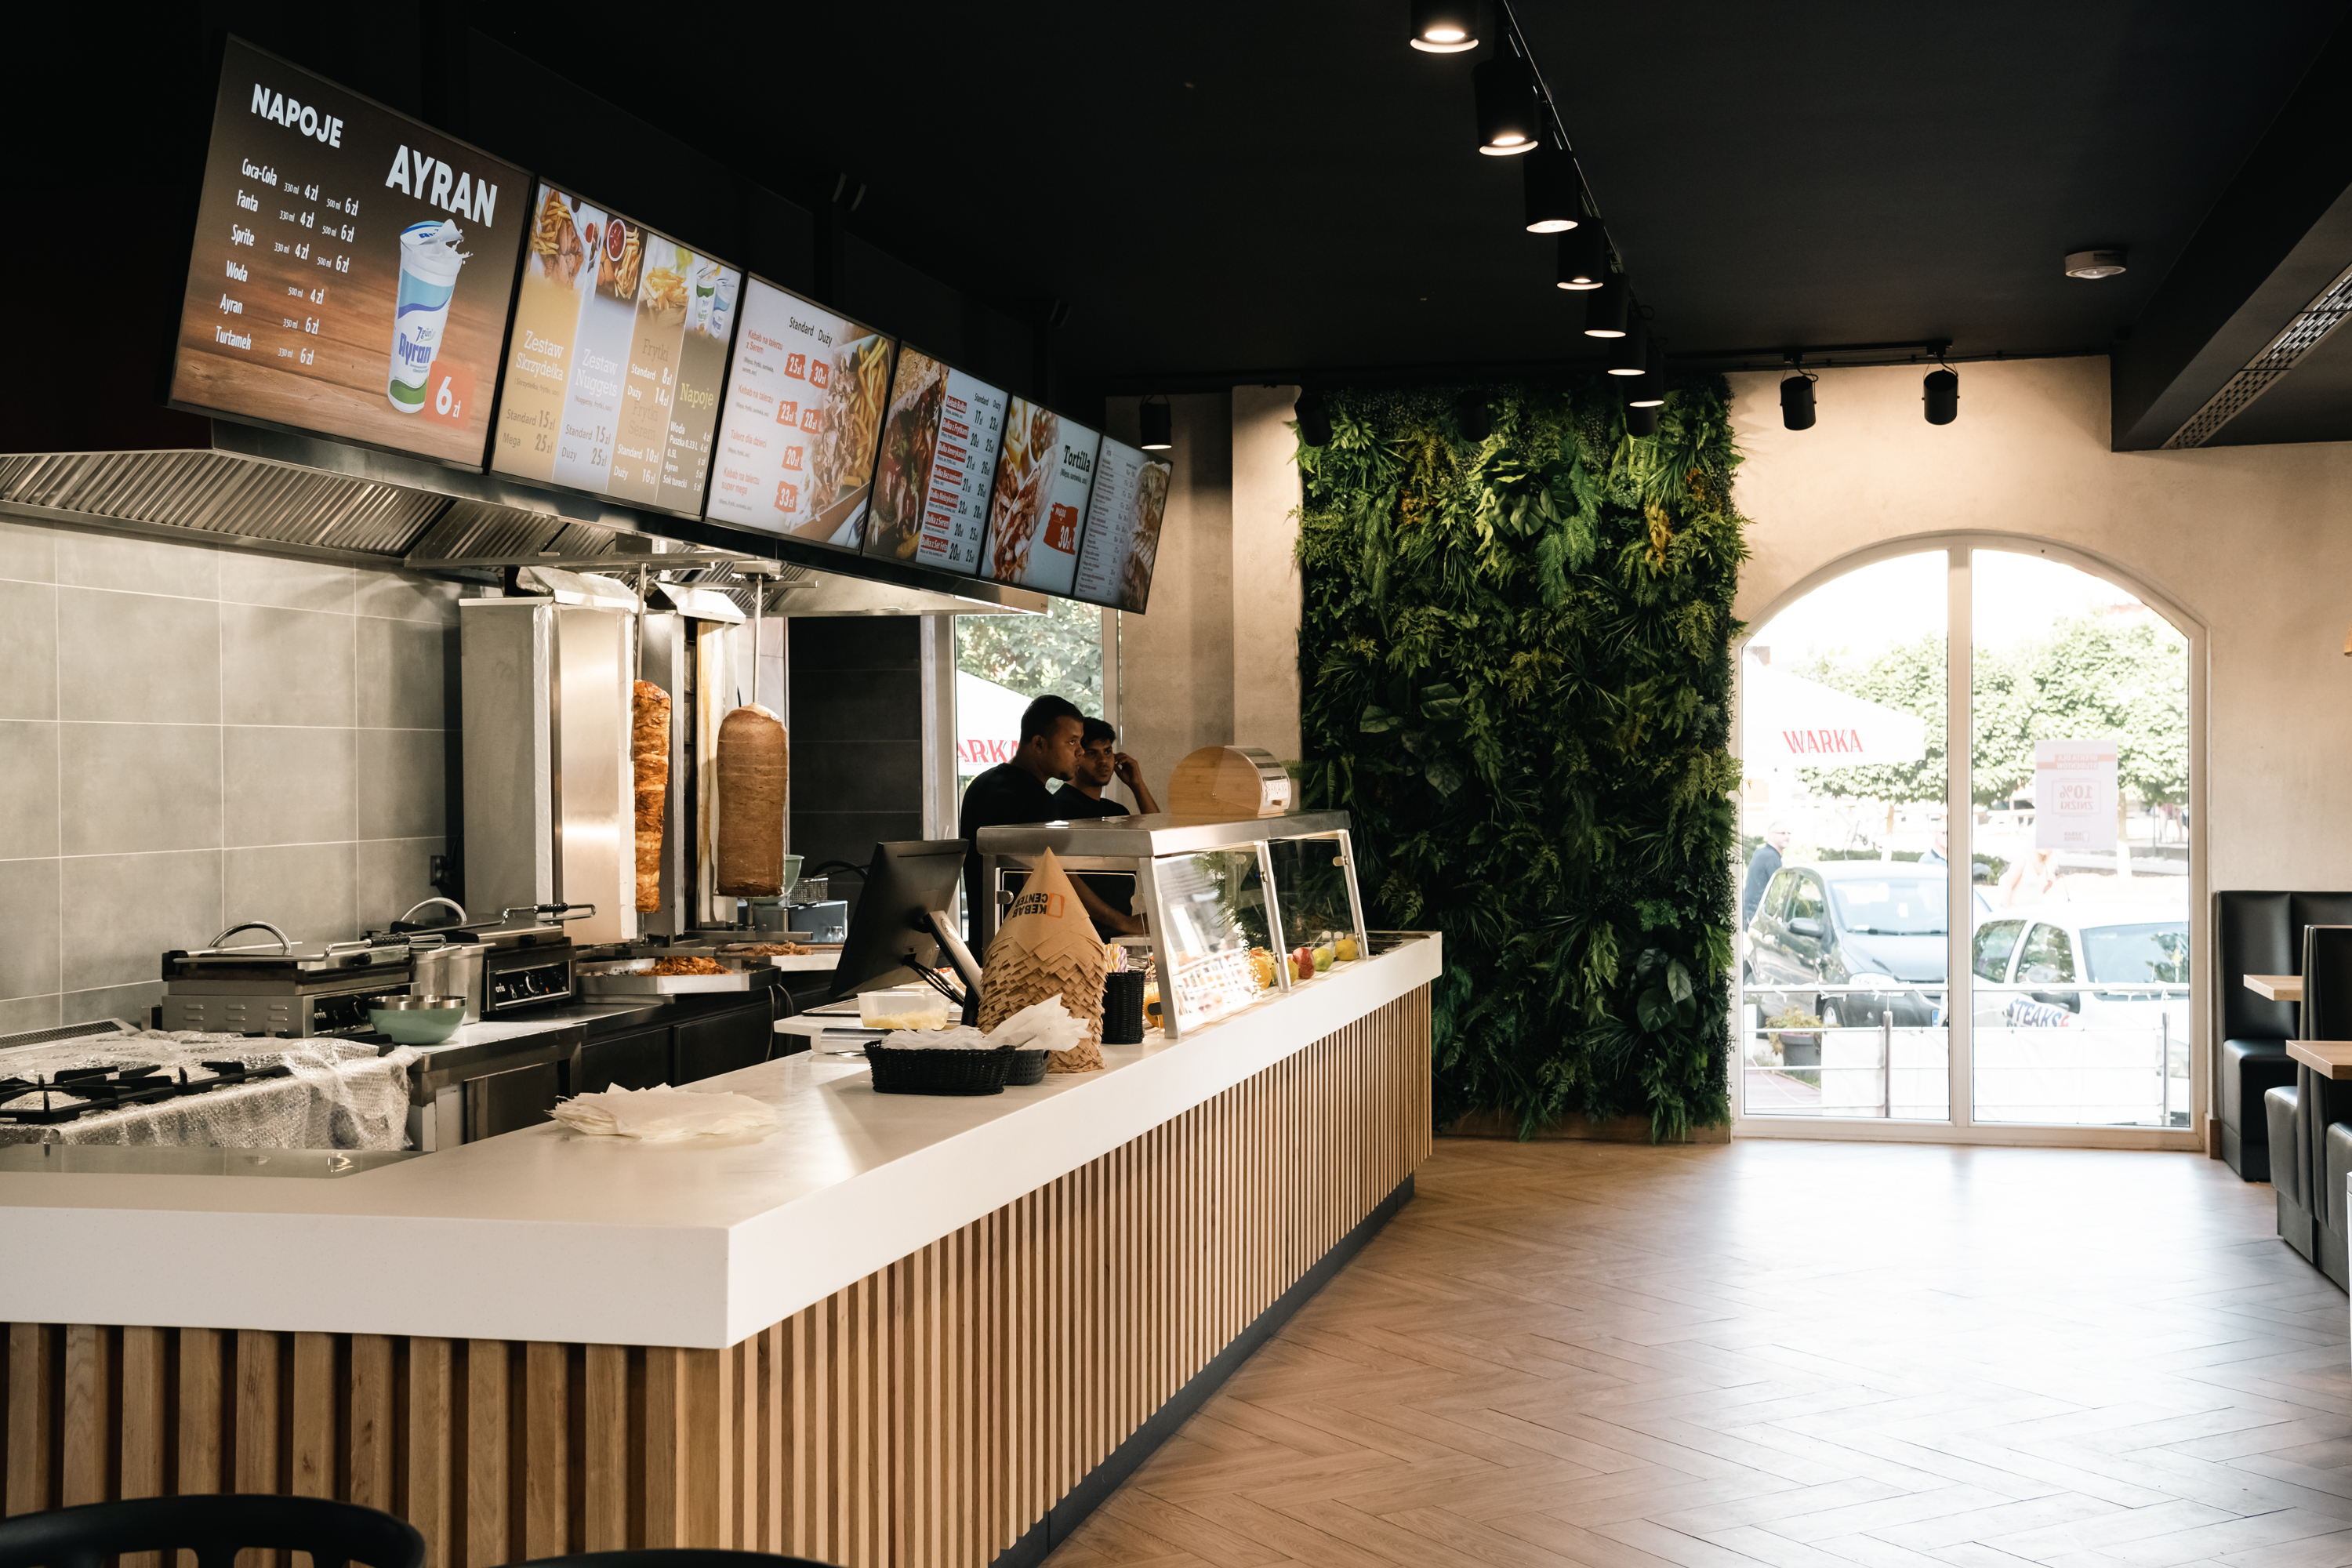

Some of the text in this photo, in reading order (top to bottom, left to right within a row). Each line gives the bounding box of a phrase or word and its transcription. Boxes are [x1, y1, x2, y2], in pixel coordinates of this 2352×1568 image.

[251, 83, 343, 149] NAPOJE
[241, 158, 278, 187] Coca-Cola
[284, 182, 293, 193] 330
[304, 184, 310, 198] 4
[326, 198, 336, 209] 500
[345, 198, 351, 213] 6
[386, 144, 498, 227] AYRAN
[237, 189, 259, 212] Fanta
[279, 210, 289, 220] 330
[299, 212, 306, 226] 4
[321, 226, 331, 235] 500
[340, 224, 347, 240] 6
[231, 223, 255, 246] Sprite
[274, 242, 284, 252] 330
[295, 243, 301, 258] 4
[317, 256, 326, 267] 500
[336, 255, 343, 271] 6
[226, 260, 249, 282] Woda
[288, 287, 298, 296] 500
[310, 289, 316, 303] 4
[220, 293, 243, 314] Ayran
[283, 318, 292, 328] 350
[305, 317, 312, 333] 6
[524, 329, 564, 359] Zestaw
[748, 329, 783, 350] Kebab na talerzu
[789, 316, 833, 348] Standard Duży
[216, 325, 252, 350] Turtamek
[278, 347, 287, 358] 330
[299, 347, 307, 364] 6
[398, 332, 432, 365] Ayran
[641, 338, 669, 362] Frytki
[750, 342, 764, 354] Serem
[516, 352, 564, 381] Skrzydełka
[582, 348, 619, 376] Zestaw
[630, 363, 656, 381] Standard
[575, 368, 618, 397] Nuggets
[627, 385, 642, 401] Duży
[738, 384, 753, 397] Kebab
[759, 392, 775, 404] talerzu
[436, 376, 461, 418] 6 zł
[679, 383, 714, 410] Napoje
[506, 408, 536, 426] Standard
[632, 400, 659, 423] Frytki
[564, 423, 593, 441] Standard
[670, 420, 685, 435] Woda
[731, 429, 745, 442] Talerz
[753, 436, 768, 448] dzieci
[502, 432, 521, 448] Mega
[618, 444, 643, 459] Standard
[670, 434, 685, 447] Puszka
[561, 446, 578, 463] Duży
[1063, 444, 1091, 474] Tortilla
[613, 466, 629, 481] Duży
[665, 461, 679, 473] Ayran
[723, 466, 738, 479] Kebab
[1782, 729, 1864, 754] WARKA
[1013, 904, 1047, 918] KEBAB
